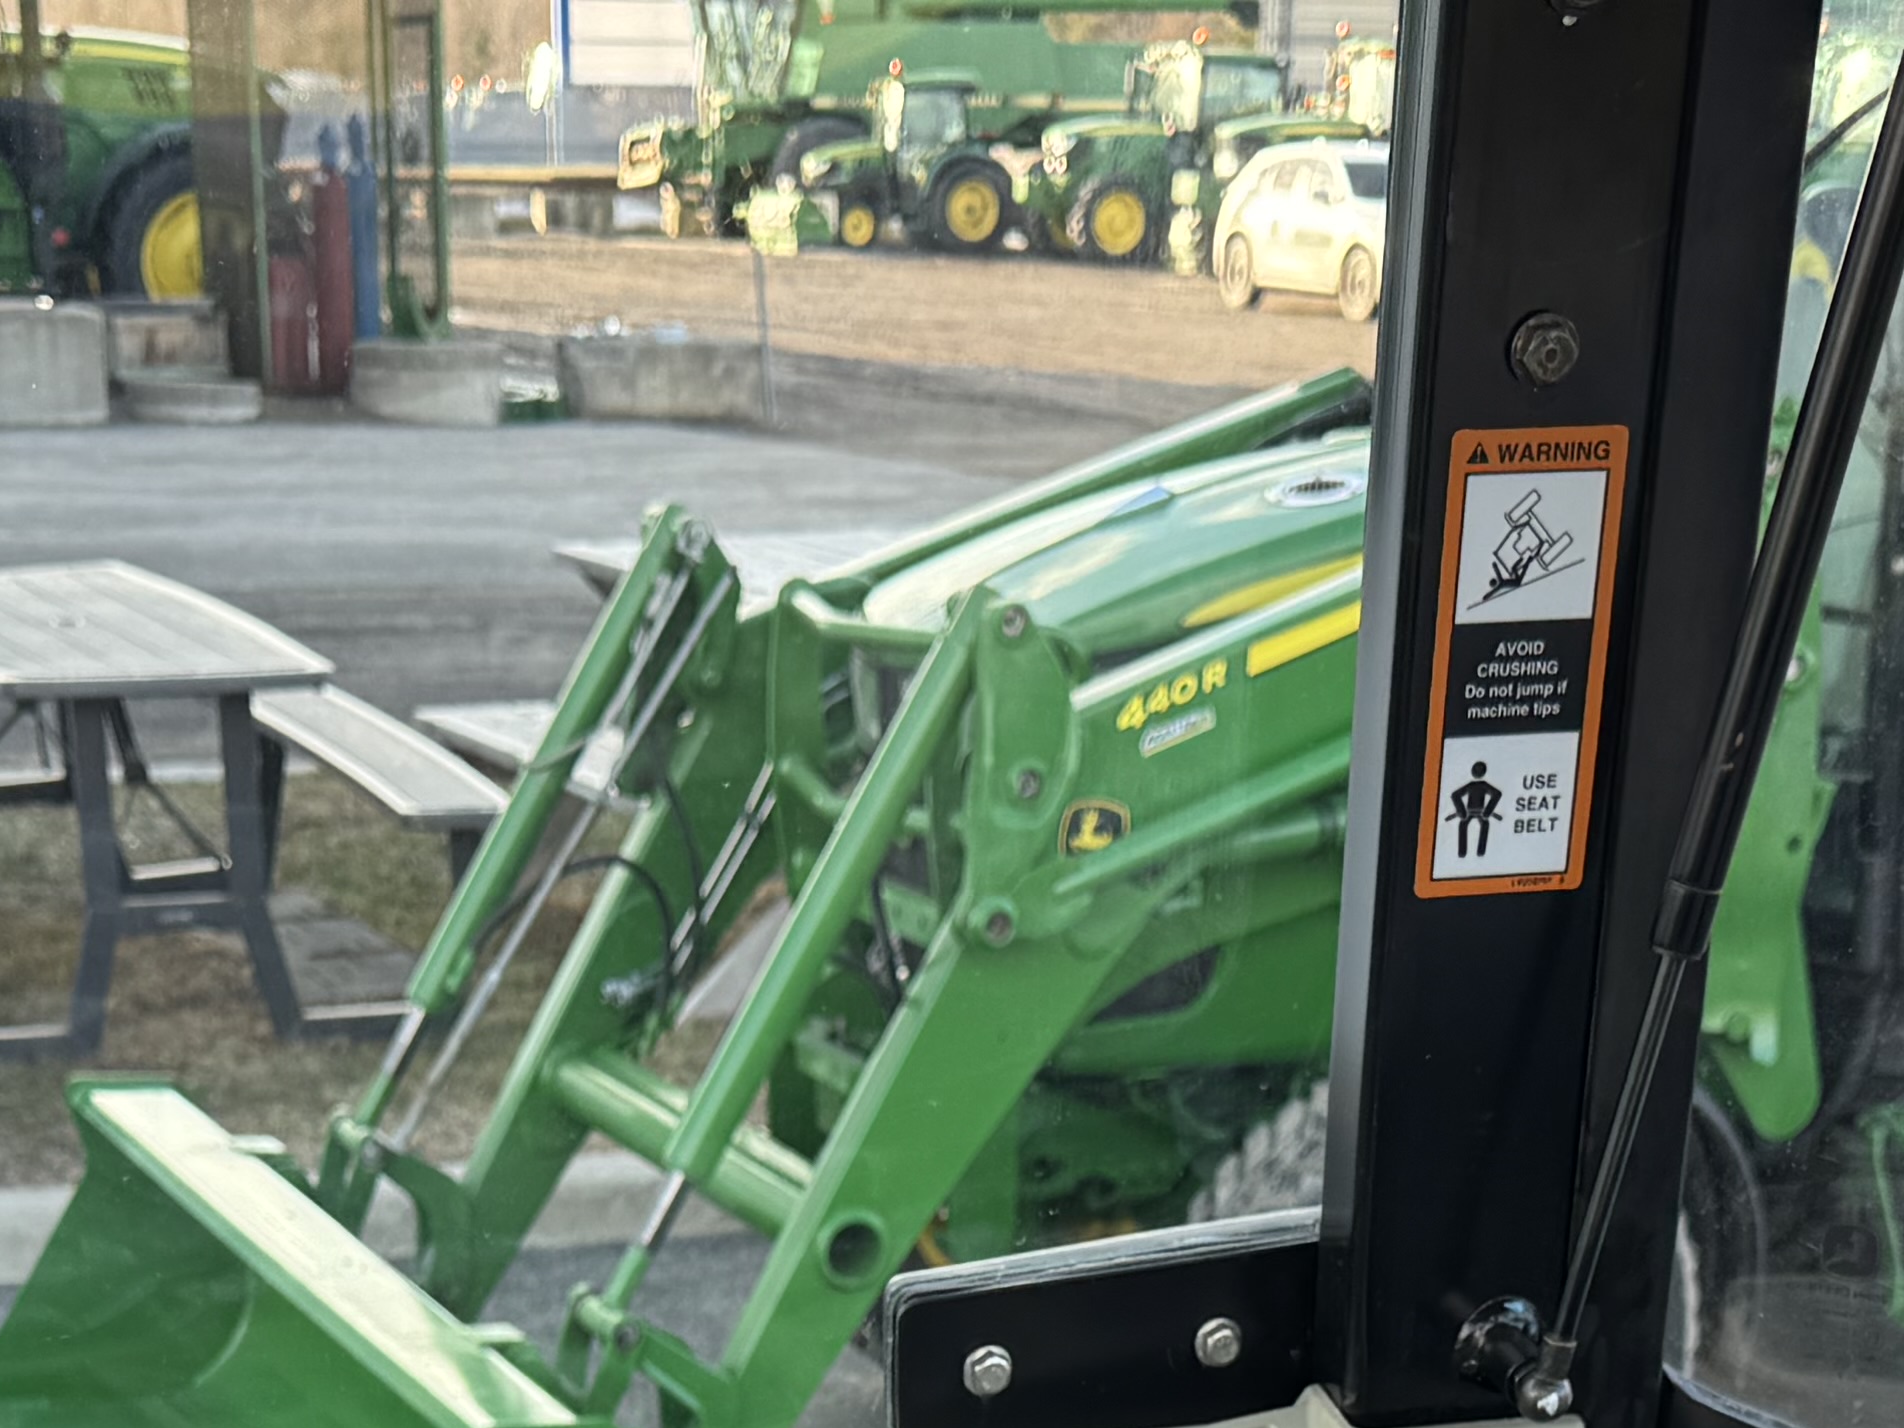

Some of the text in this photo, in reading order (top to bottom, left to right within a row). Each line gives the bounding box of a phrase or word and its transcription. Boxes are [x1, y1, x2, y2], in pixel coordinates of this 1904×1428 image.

[1497, 440, 1611, 464] WARNING
[1495, 641, 1545, 657] AVOID
[1477, 660, 1559, 678] CRUSHING
[1116, 658, 1228, 732] 440R
[1465, 678, 1568, 700] Do not jump if
[1467, 701, 1561, 719] machine tips
[1522, 773, 1558, 791] USE
[1515, 795, 1561, 812] SEAT
[1513, 816, 1559, 834] BELT
